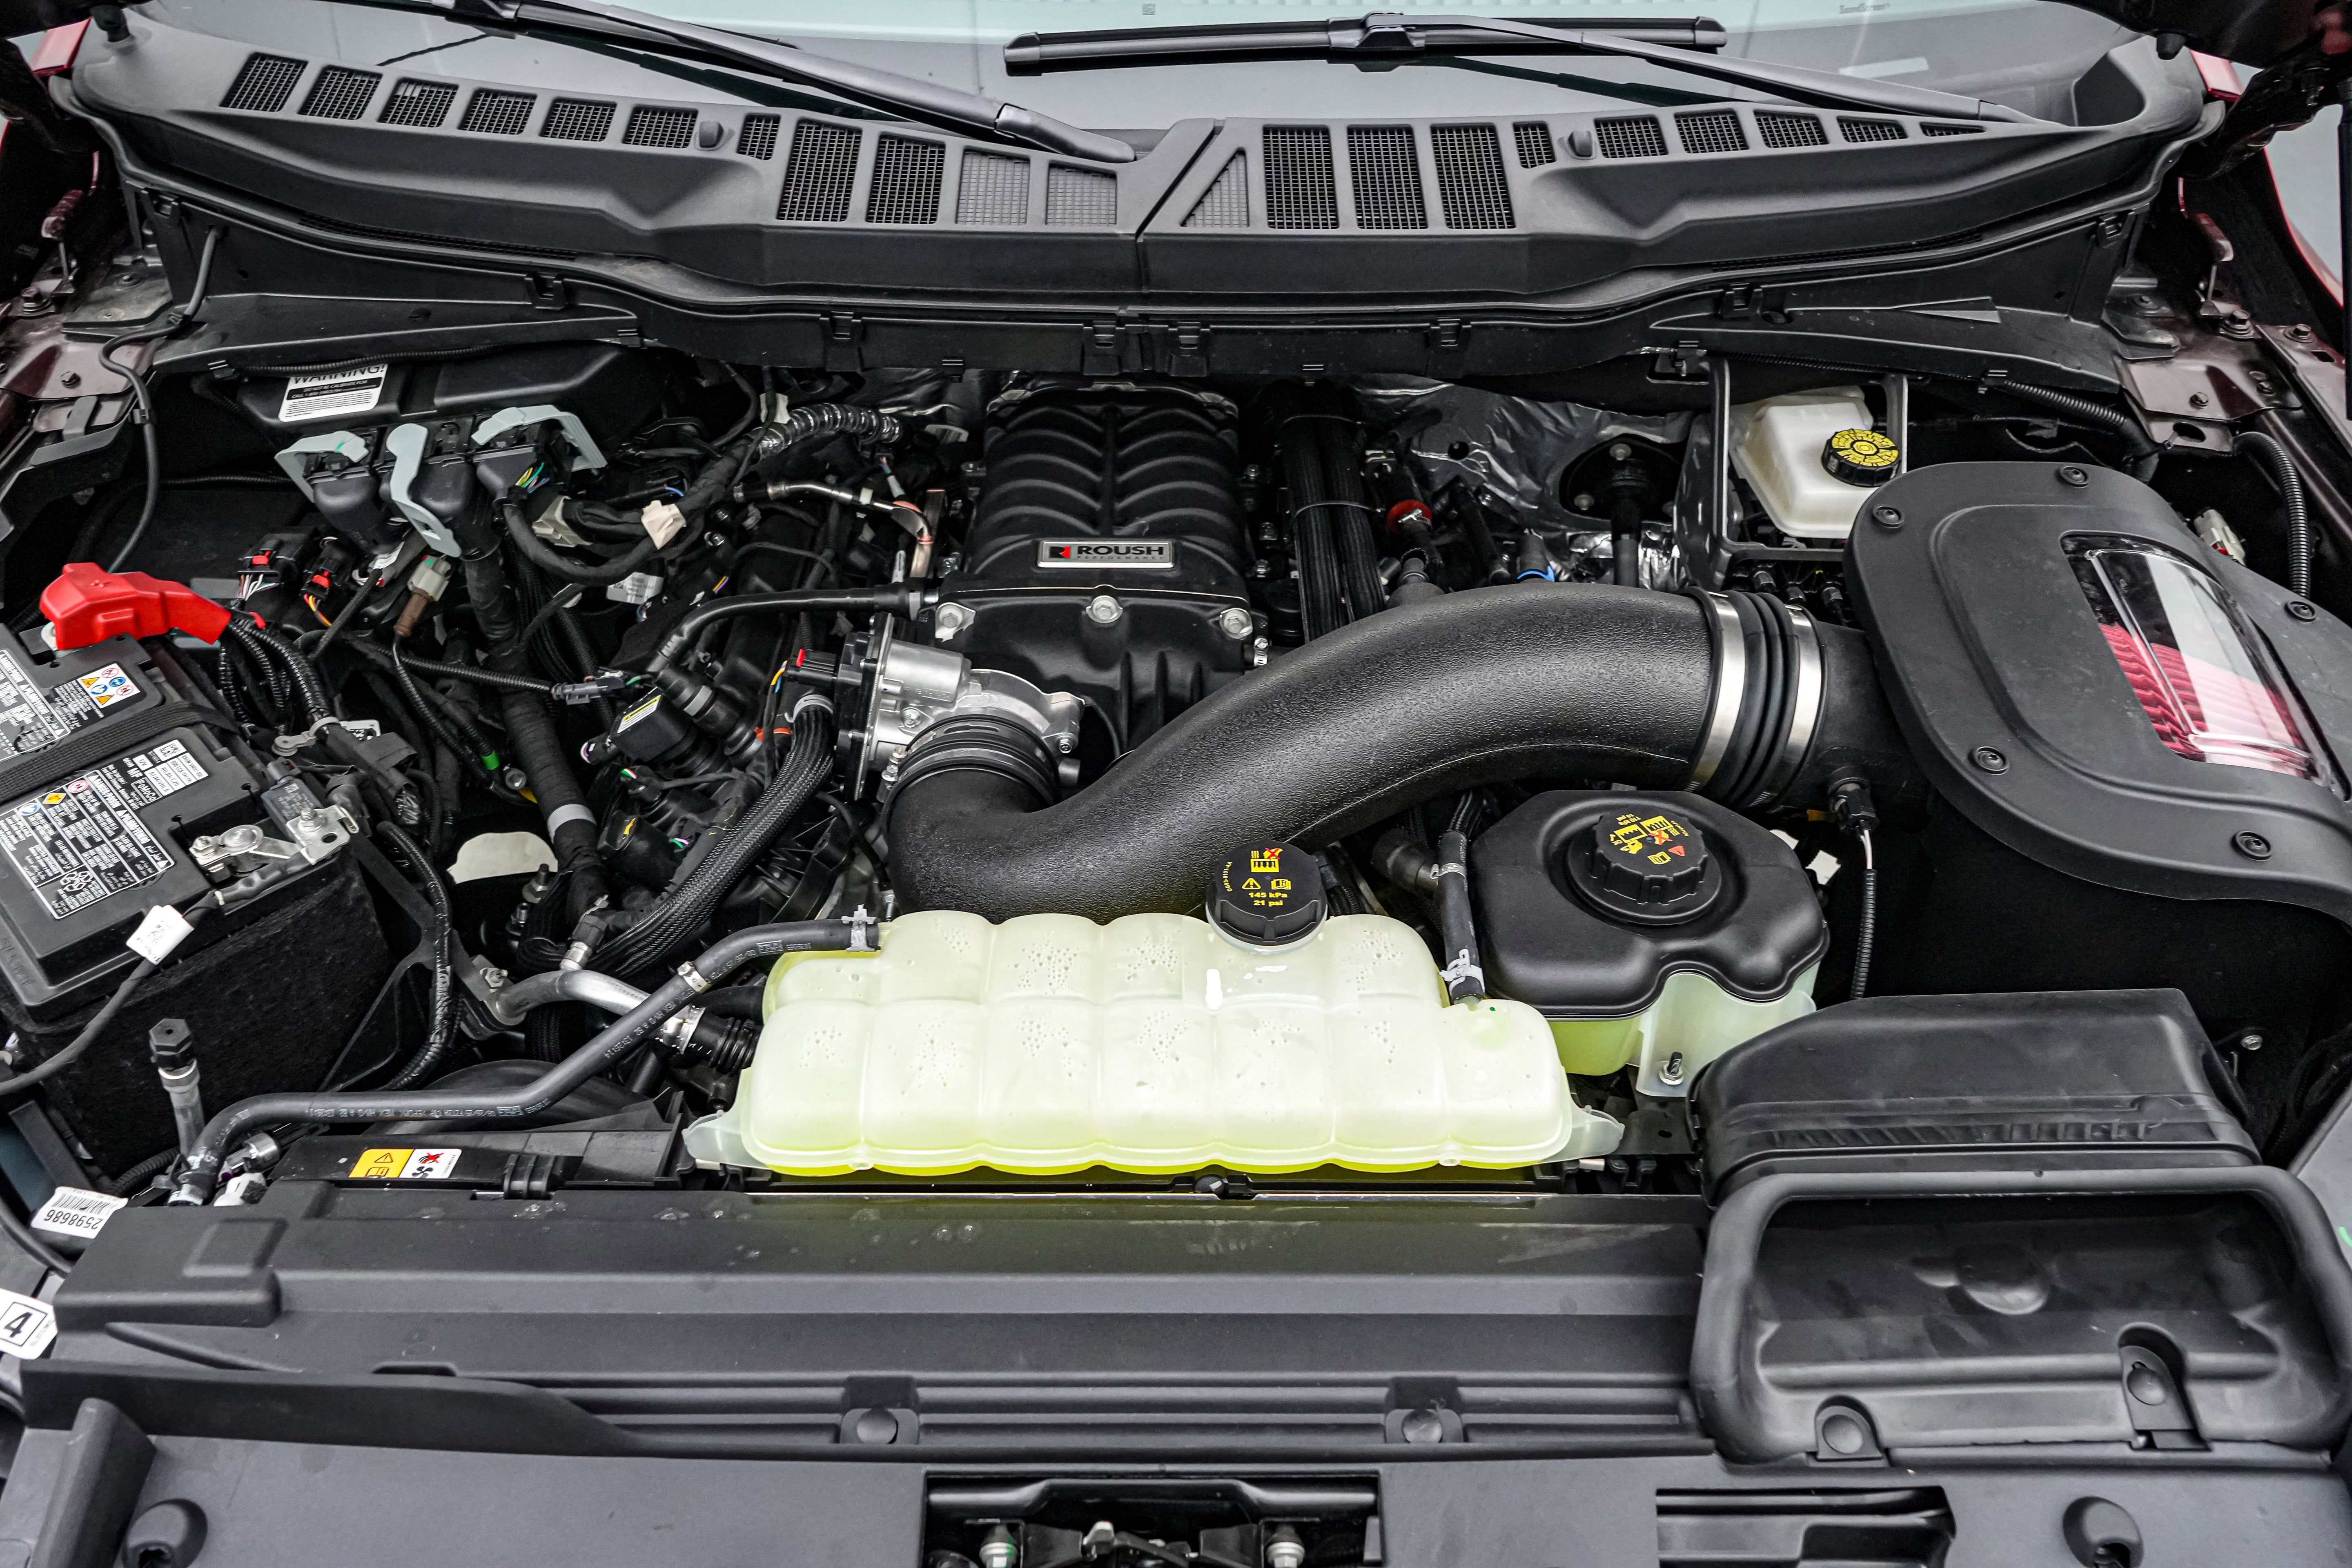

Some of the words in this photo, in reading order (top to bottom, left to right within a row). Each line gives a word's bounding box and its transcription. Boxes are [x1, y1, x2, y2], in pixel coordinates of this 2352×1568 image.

[1078, 546, 1163, 555] ROUSH
[127, 767, 143, 778] MF
[135, 779, 156, 801] FoMoCo
[170, 778, 180, 786] C20
[44, 1209, 103, 1230] 2598686
[3, 1312, 32, 1338] 4
